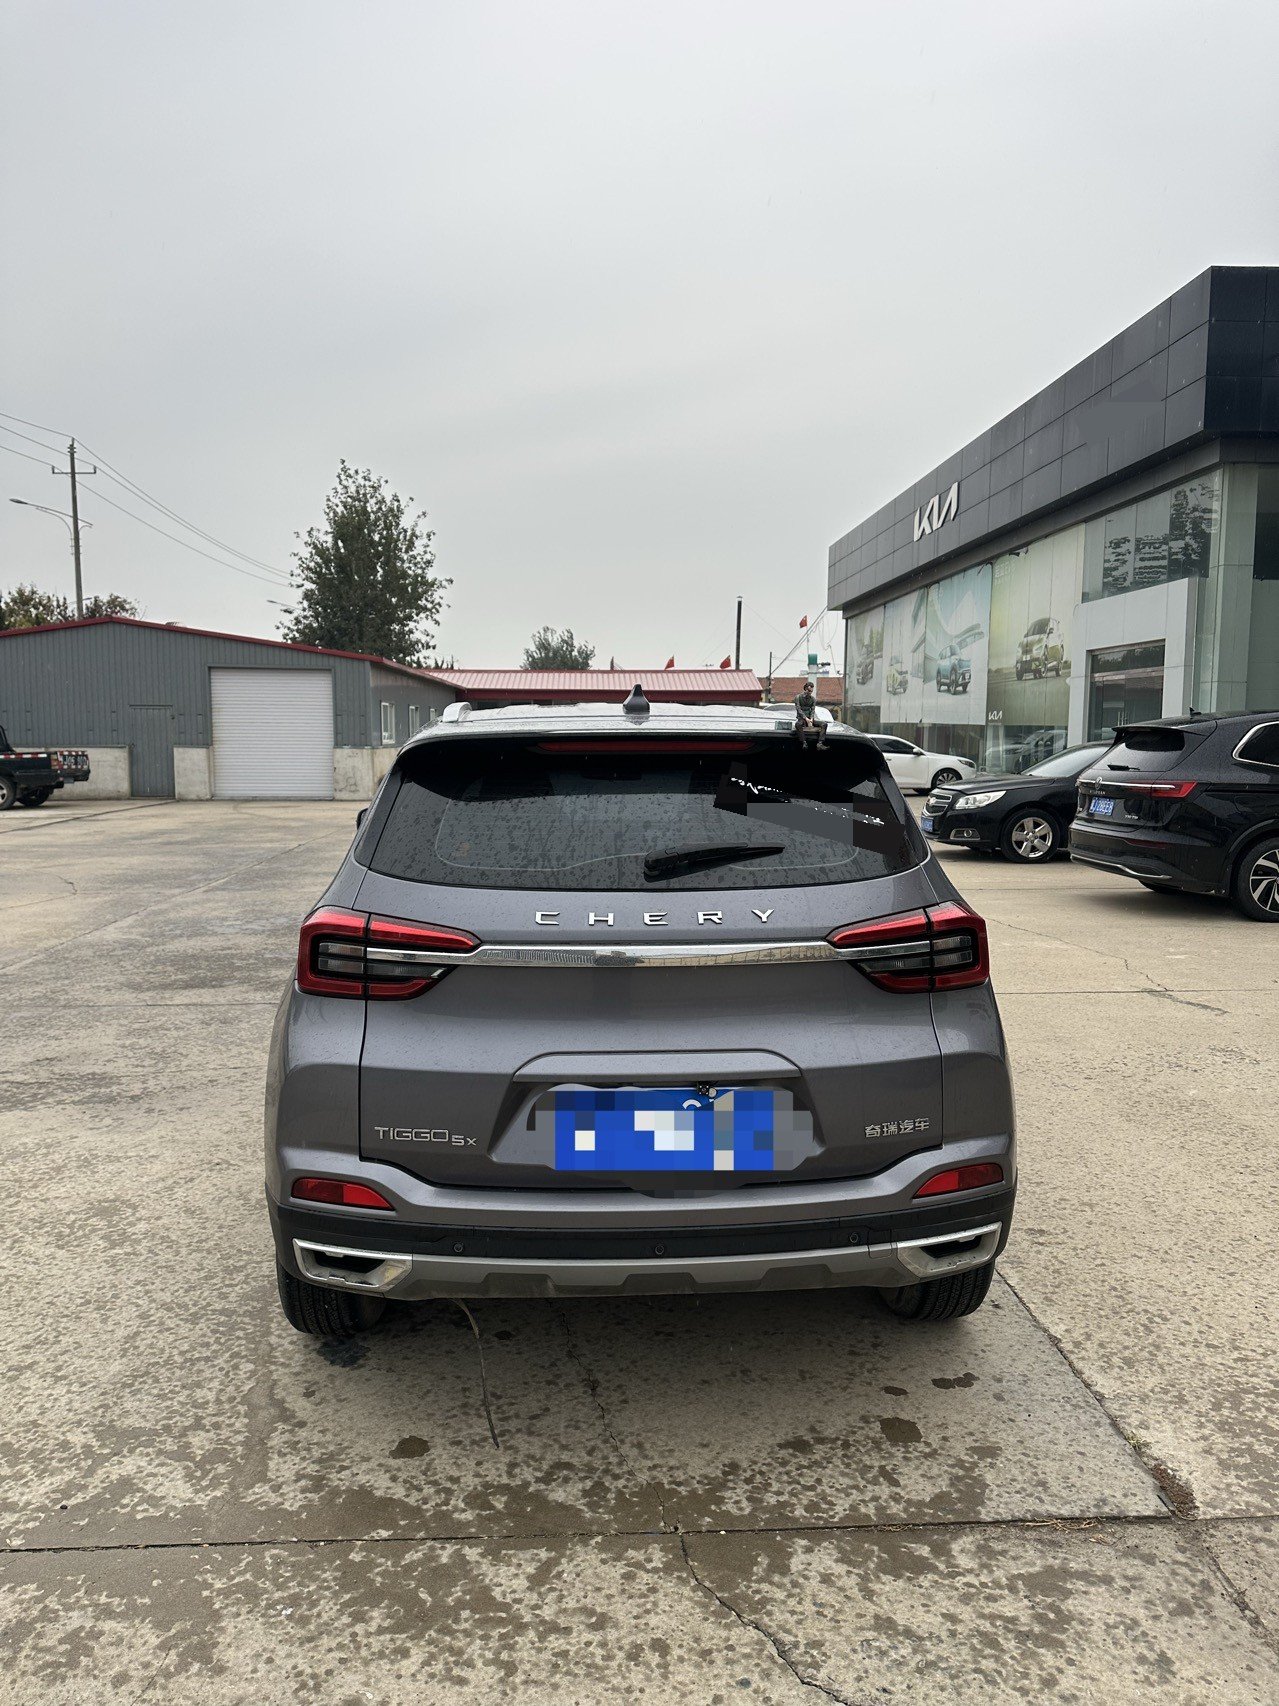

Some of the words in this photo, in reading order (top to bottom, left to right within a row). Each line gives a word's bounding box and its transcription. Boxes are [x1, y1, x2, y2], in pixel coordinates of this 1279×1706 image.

[535, 909, 775, 926] CHERY
[374, 1126, 449, 1142] TIGGO
[865, 1117, 930, 1138] 奇瑞汽车
